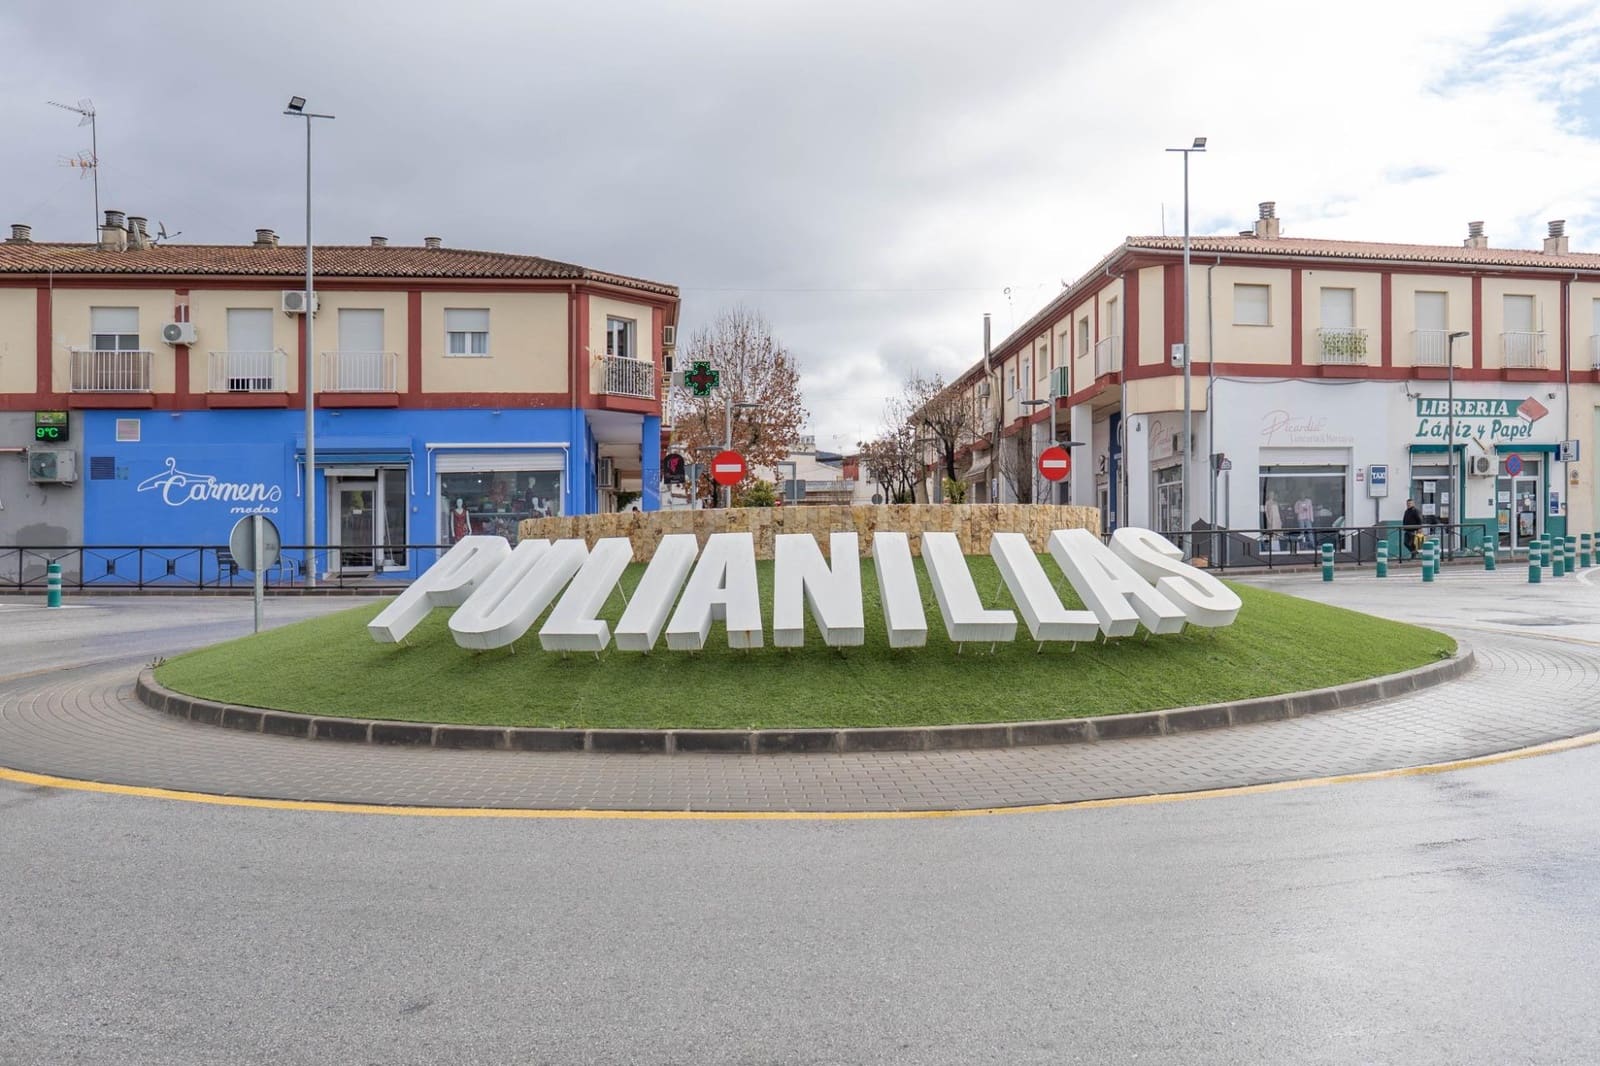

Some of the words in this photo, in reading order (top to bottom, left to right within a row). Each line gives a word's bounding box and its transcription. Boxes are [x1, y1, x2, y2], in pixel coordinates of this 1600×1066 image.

[36, 427, 59, 438] 9°C
[1415, 418, 1472, 441] Lápiz
[1477, 423, 1486, 440] y
[1490, 419, 1534, 441] Papel
[162, 475, 281, 506] Carmen
[230, 503, 279, 514] modas
[367, 527, 1242, 652] PULIANILLAS
